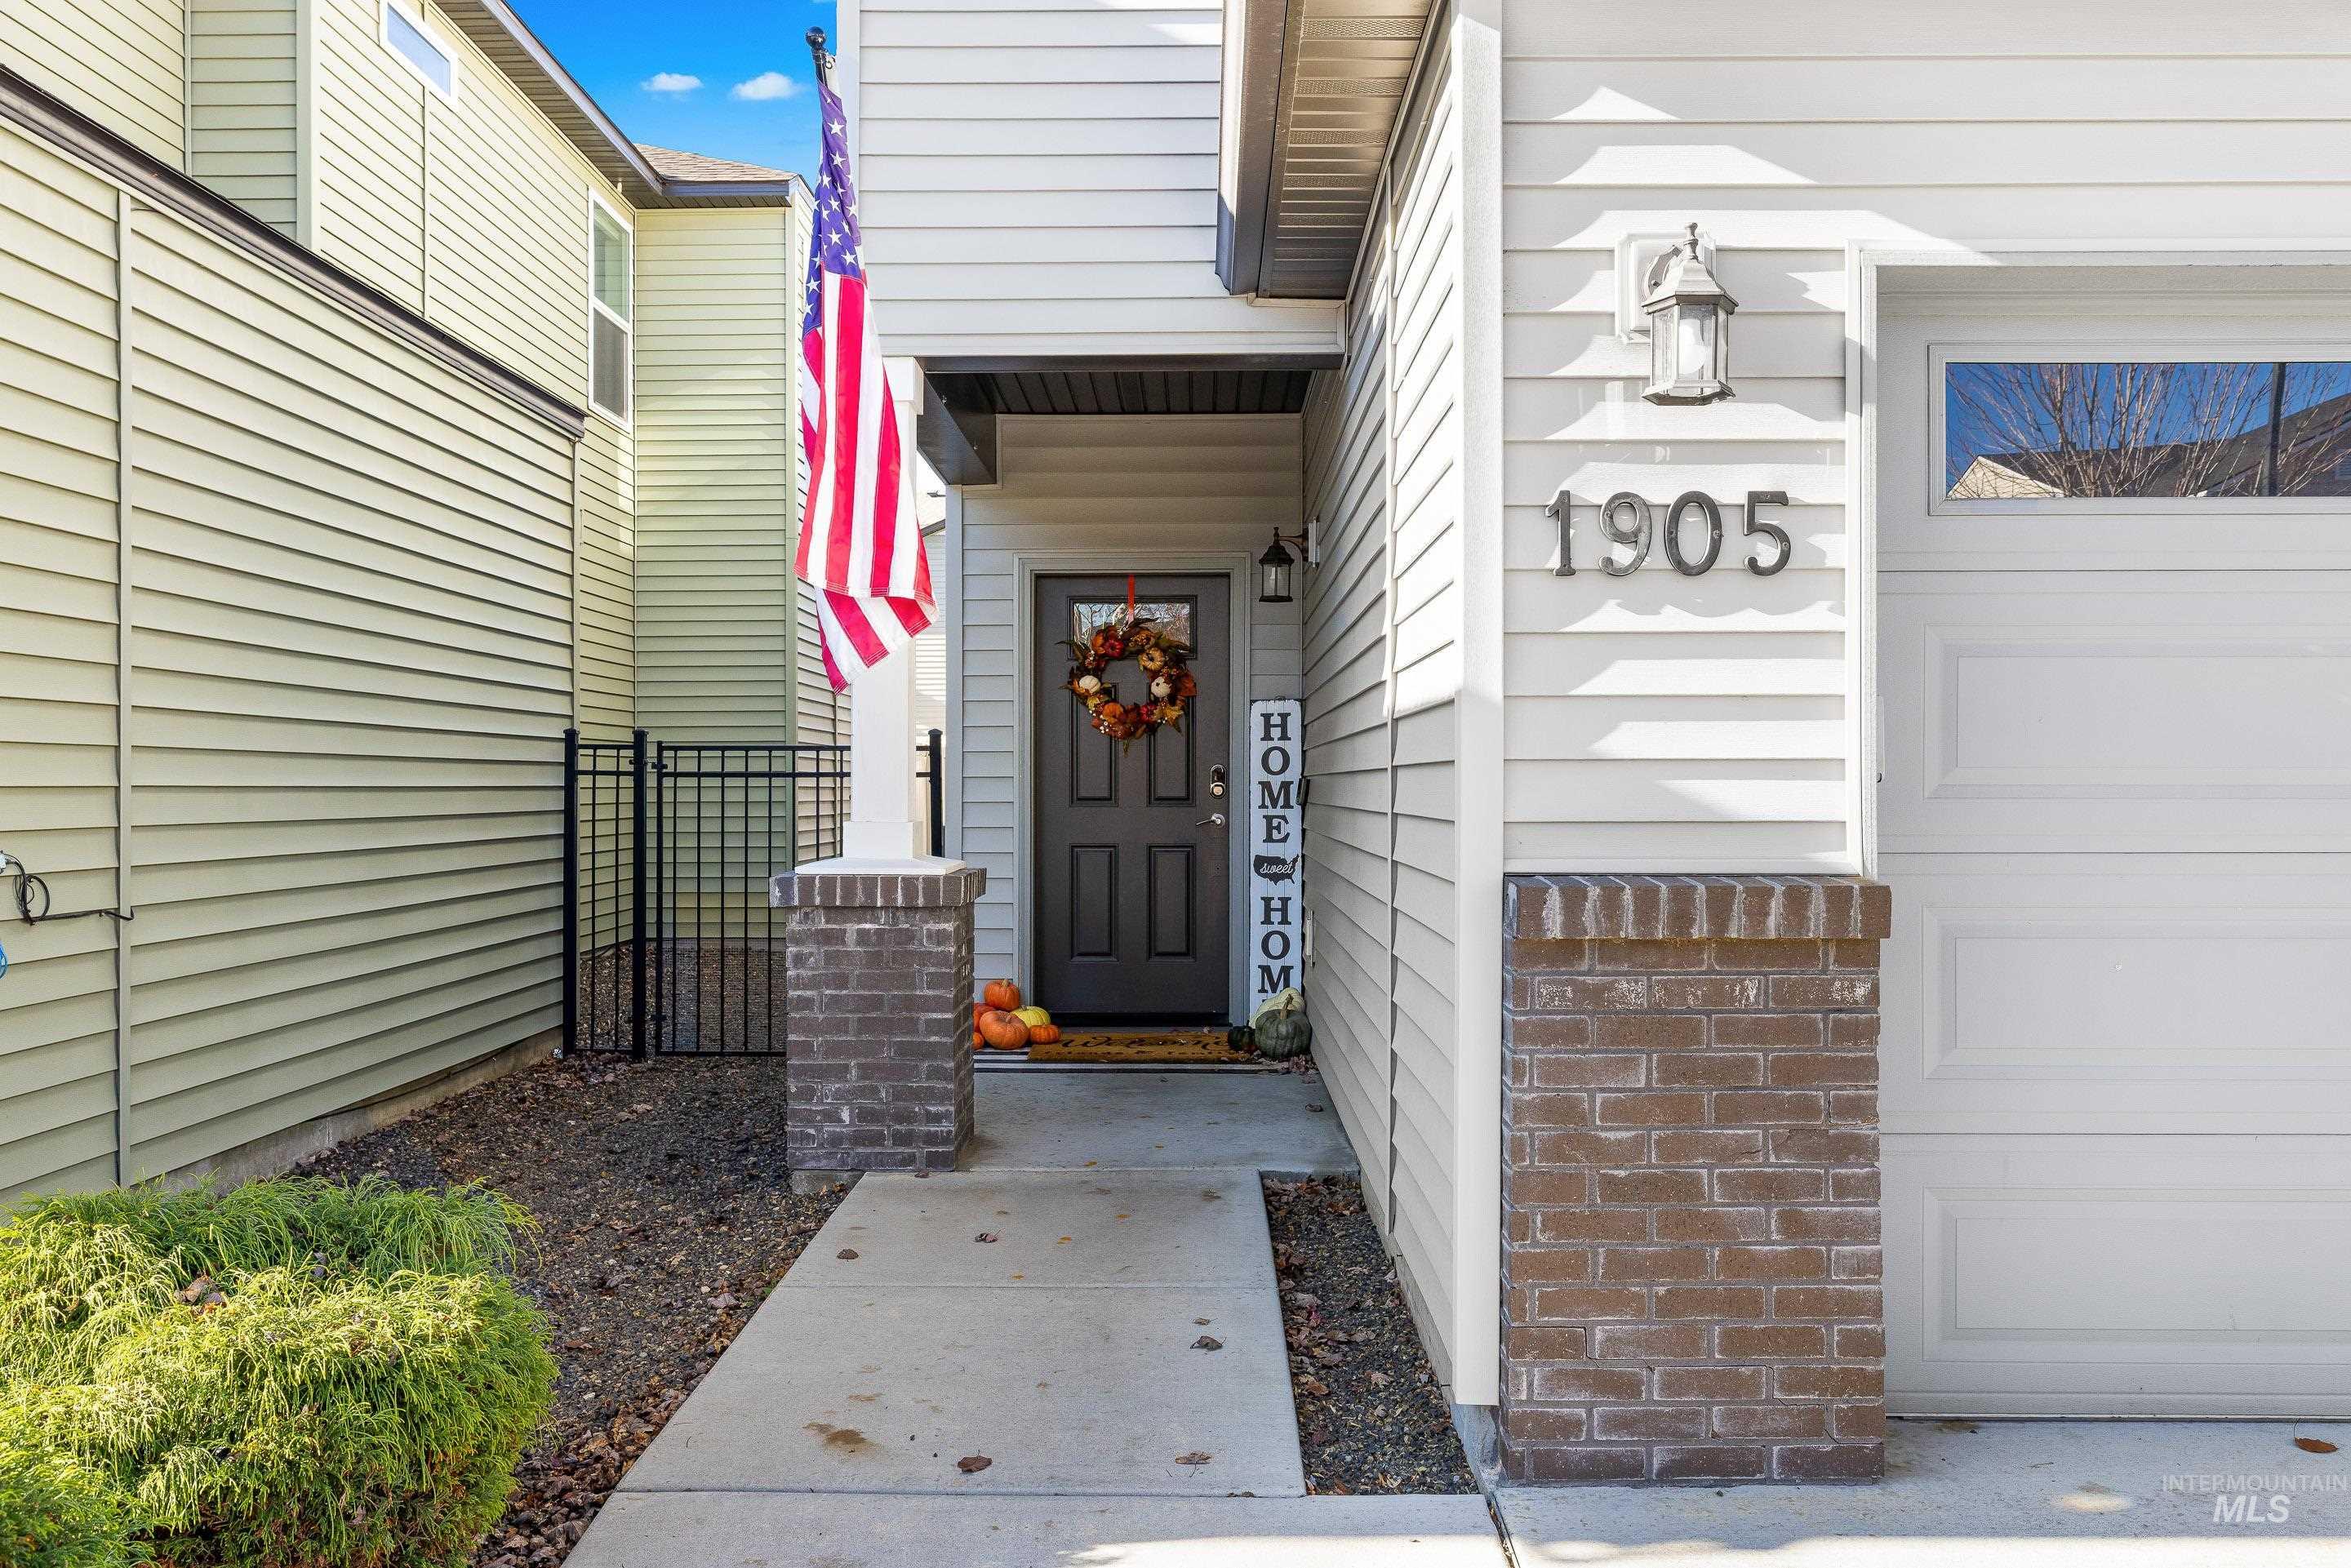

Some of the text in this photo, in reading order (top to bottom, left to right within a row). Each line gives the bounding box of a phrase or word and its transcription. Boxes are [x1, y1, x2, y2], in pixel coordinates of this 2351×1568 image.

[1545, 490, 1792, 576] 1905
[1257, 712, 1294, 844] HOME
[1260, 862, 1294, 874] sweet
[1257, 896, 1294, 1007] HOM
